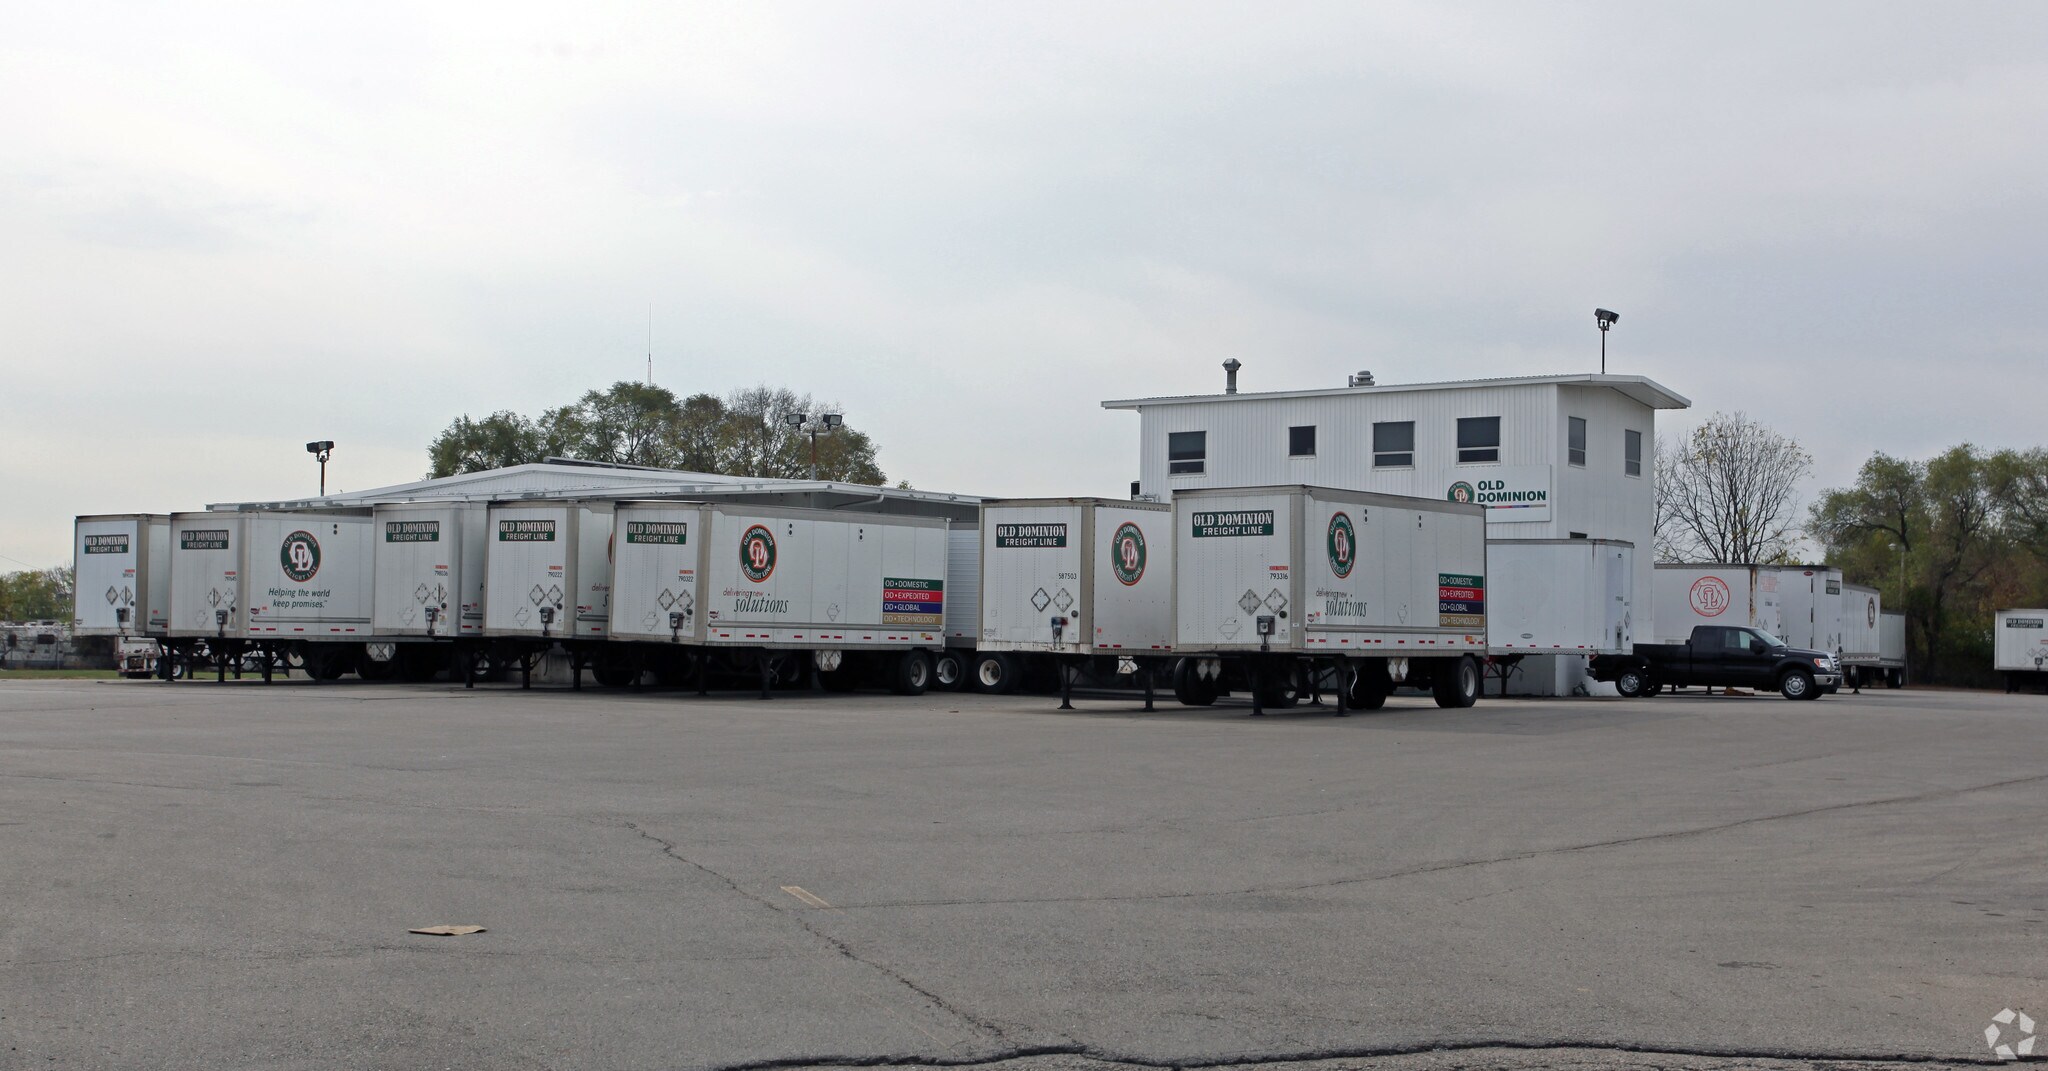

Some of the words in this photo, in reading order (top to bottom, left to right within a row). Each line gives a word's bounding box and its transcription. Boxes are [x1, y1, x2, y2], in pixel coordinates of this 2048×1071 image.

[1477, 480, 1505, 491] OLD
[1477, 491, 1547, 503] DOMINION
[1193, 514, 1215, 527] OLD
[1217, 512, 1273, 526] DOMINION
[387, 523, 401, 534] OLD
[403, 523, 439, 533] DOMINION
[500, 522, 515, 532] OLD
[517, 521, 555, 532] DOMINION
[628, 523, 644, 534] OLD
[646, 524, 686, 535] DOMINION
[998, 526, 1015, 537] OLD
[1018, 525, 1066, 537] DOMINION
[1203, 526, 1240, 536] FREIGHT
[1242, 526, 1264, 535] LINE
[86, 536, 97, 546] OLD
[98, 536, 128, 545] DOMINION
[181, 532, 194, 541] OLD
[196, 532, 228, 541] DOMINION
[634, 535, 661, 543] FREIGHT
[663, 535, 679, 543] LINE
[1005, 538, 1038, 546] FREIGHT
[1039, 538, 1057, 546] LINE
[187, 541, 209, 549] FREIGHT
[1058, 572, 1077, 580] 587503
[268, 588, 296, 598] Helping
[298, 588, 309, 597] the
[312, 589, 331, 597] world
[723, 587, 750, 599] delivering
[1315, 588, 1338, 601] delivering
[273, 600, 290, 608] keep
[733, 591, 789, 614] solutions
[1324, 592, 1368, 618] solutions
